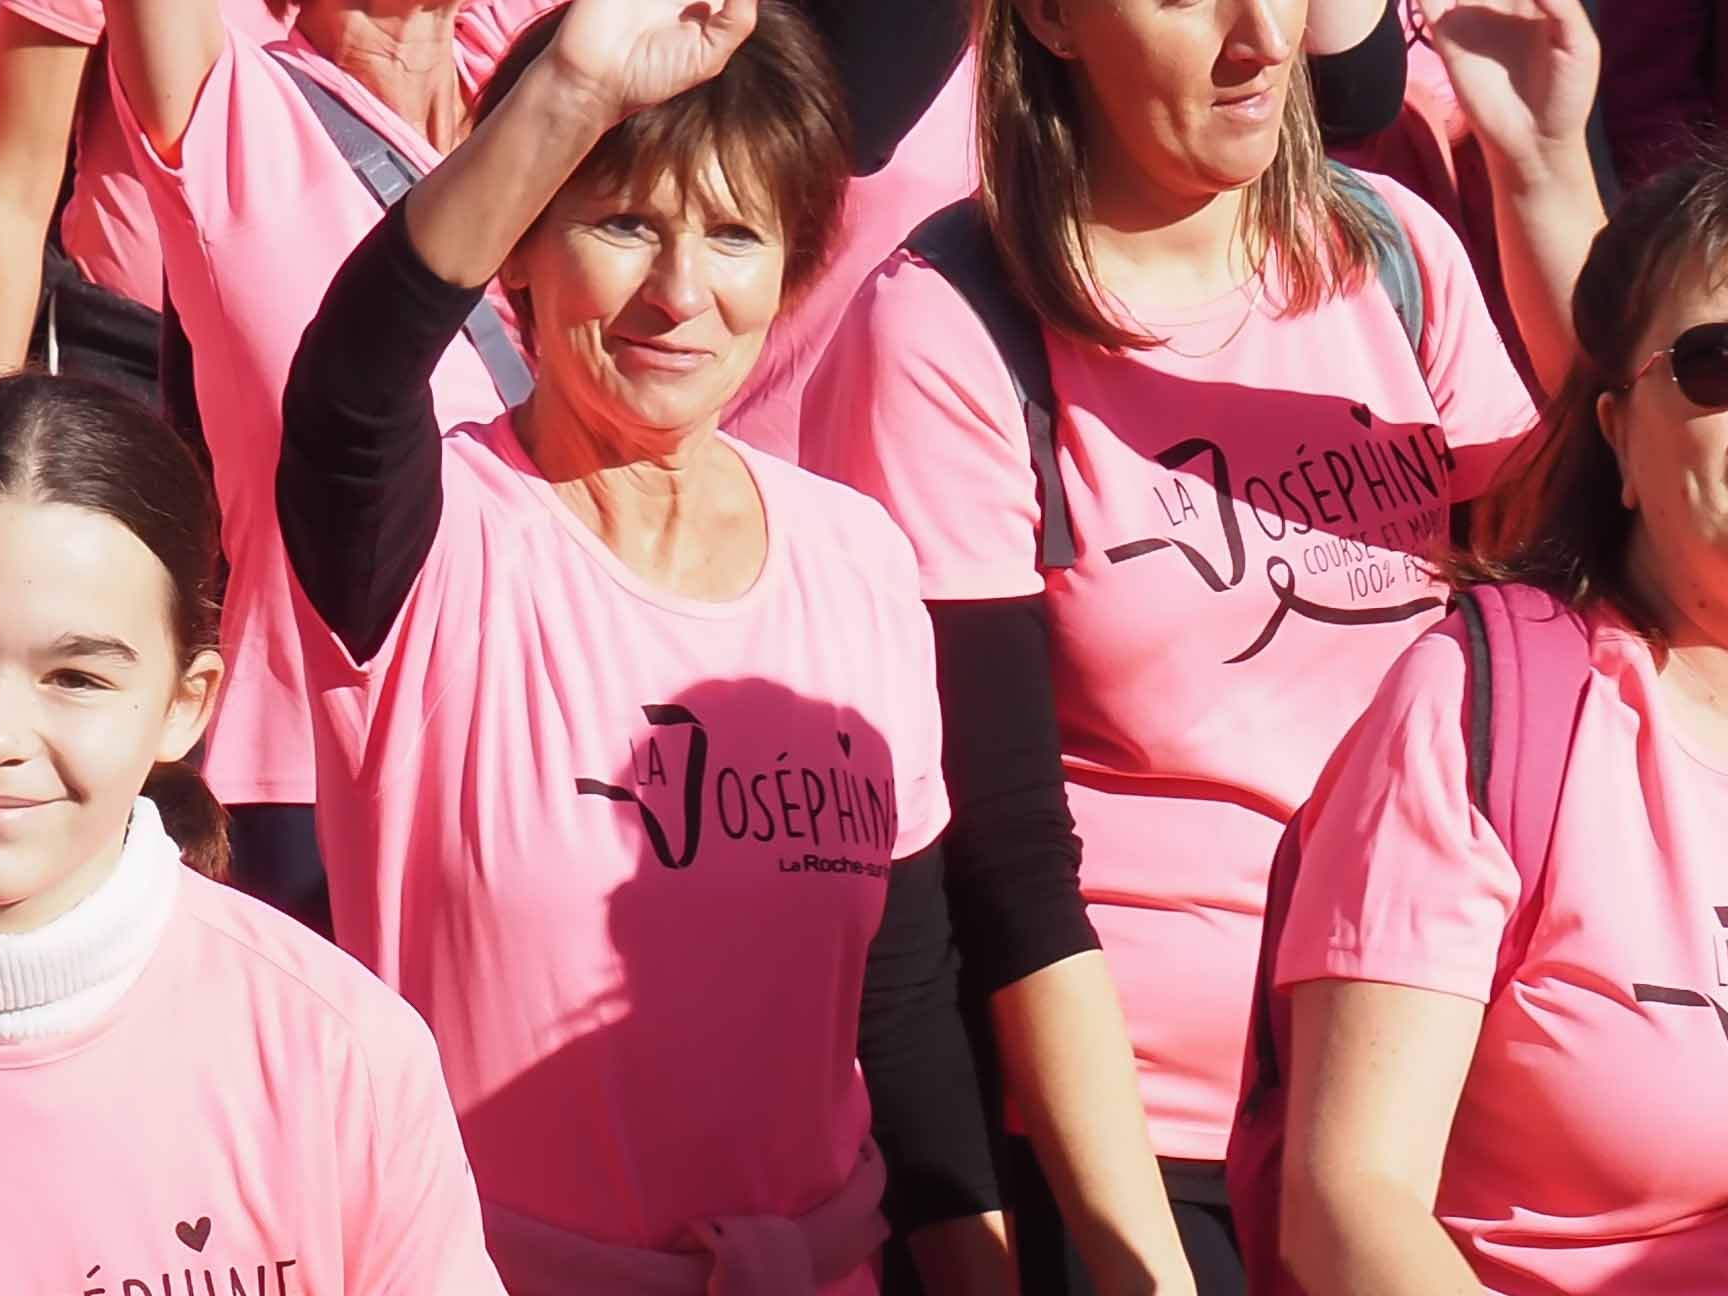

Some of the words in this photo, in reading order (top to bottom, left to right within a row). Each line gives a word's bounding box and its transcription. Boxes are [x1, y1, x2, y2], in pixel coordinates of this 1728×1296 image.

[1153, 477, 1200, 527] LA
[1303, 530, 1375, 575] COURSE
[1381, 521, 1402, 547] ET
[1346, 560, 1396, 602] 100%
[628, 735, 668, 788] LA
[640, 704, 898, 870] JOSÉPHIN
